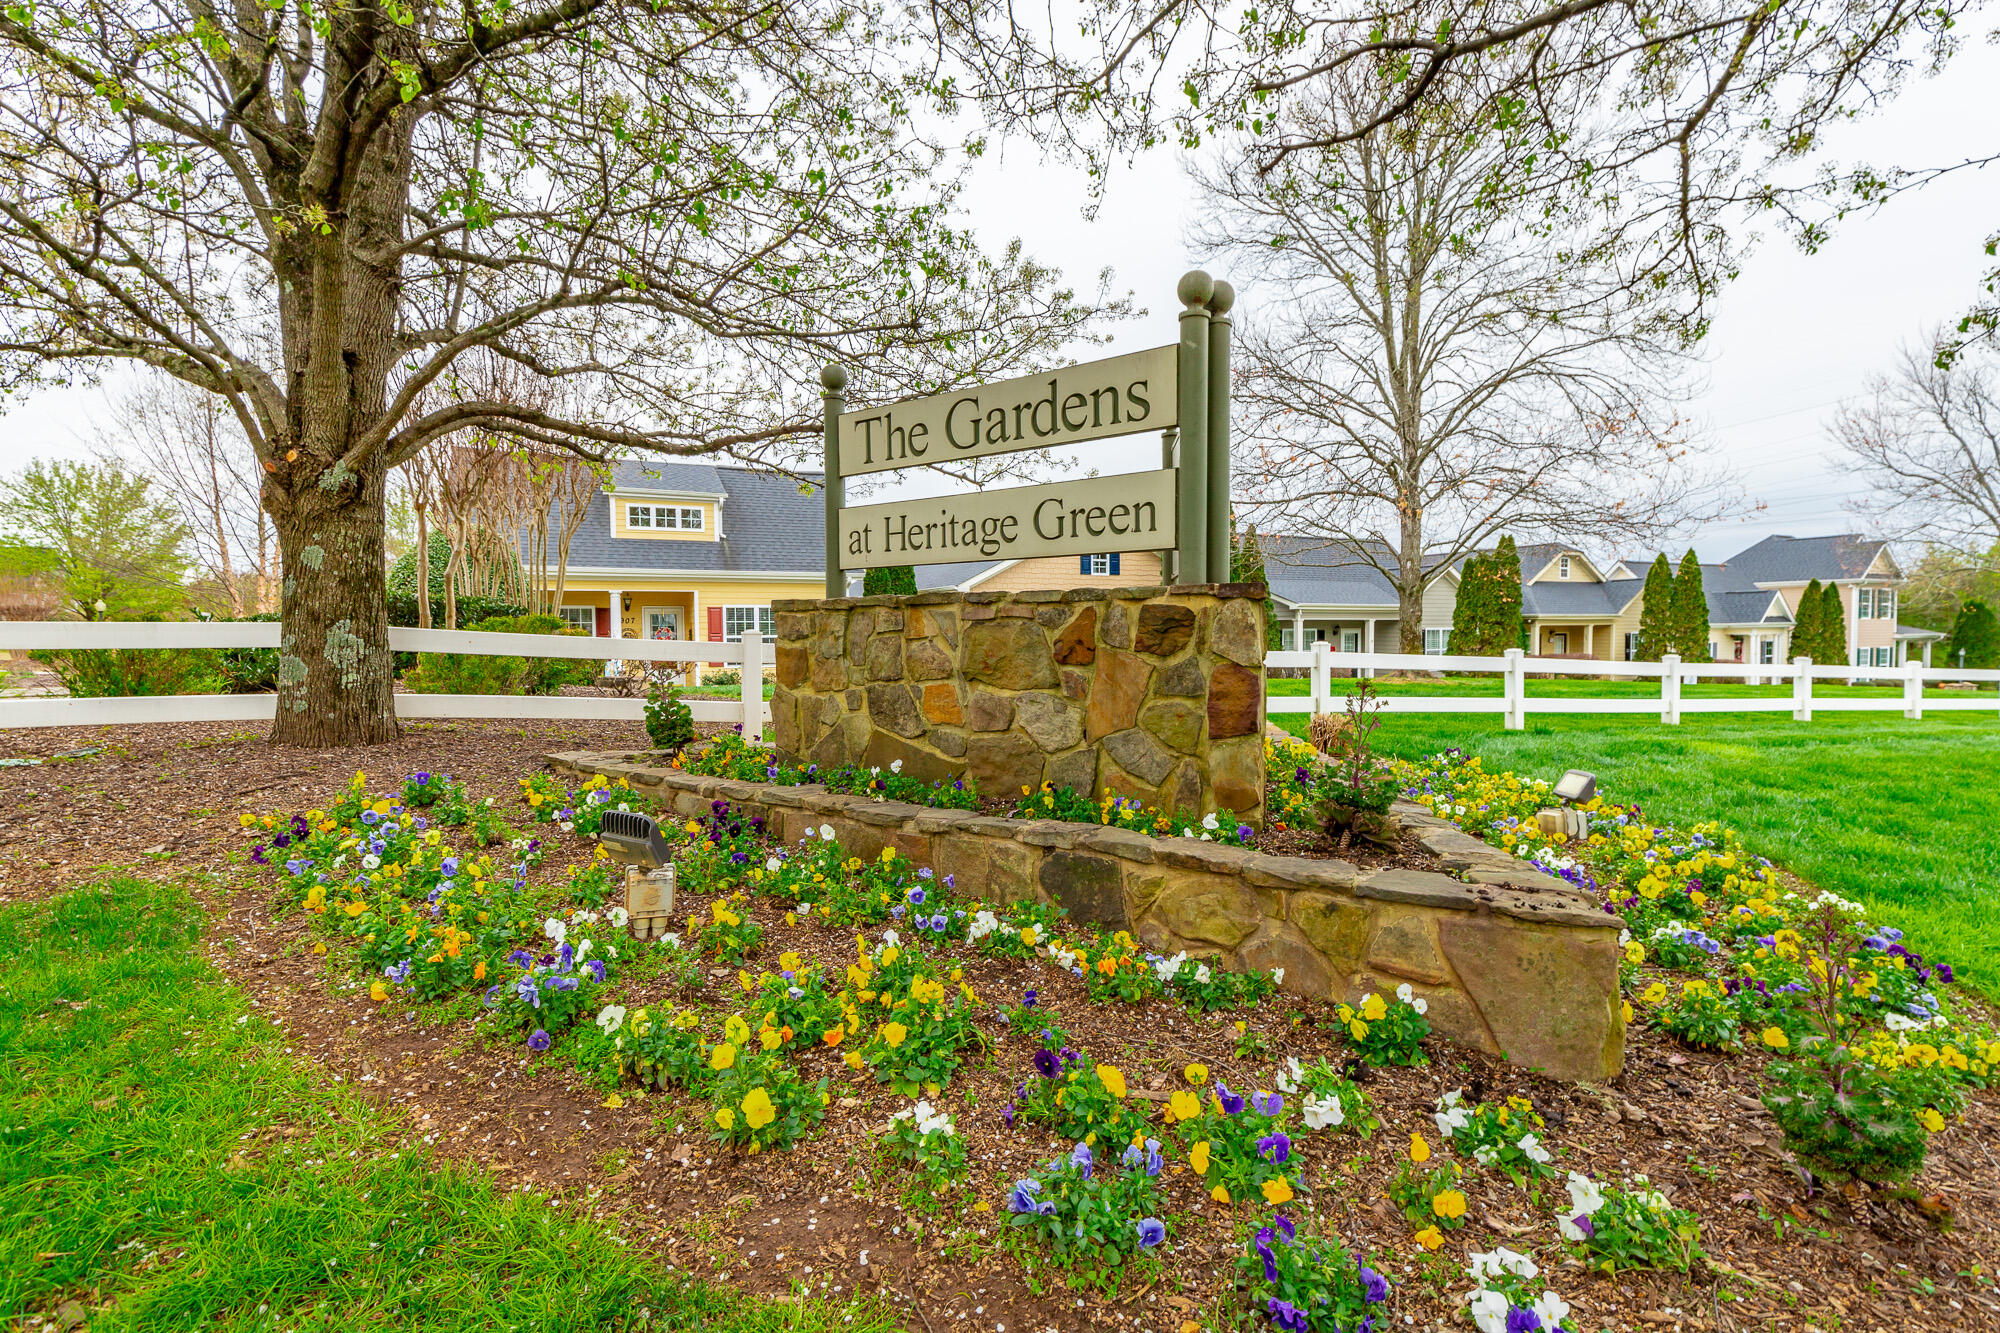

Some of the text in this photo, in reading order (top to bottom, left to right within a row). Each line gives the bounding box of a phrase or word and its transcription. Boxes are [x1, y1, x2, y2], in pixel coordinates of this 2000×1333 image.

[855, 378, 1150, 464] The Gardens
[849, 498, 1156, 556] at Heritage Green
